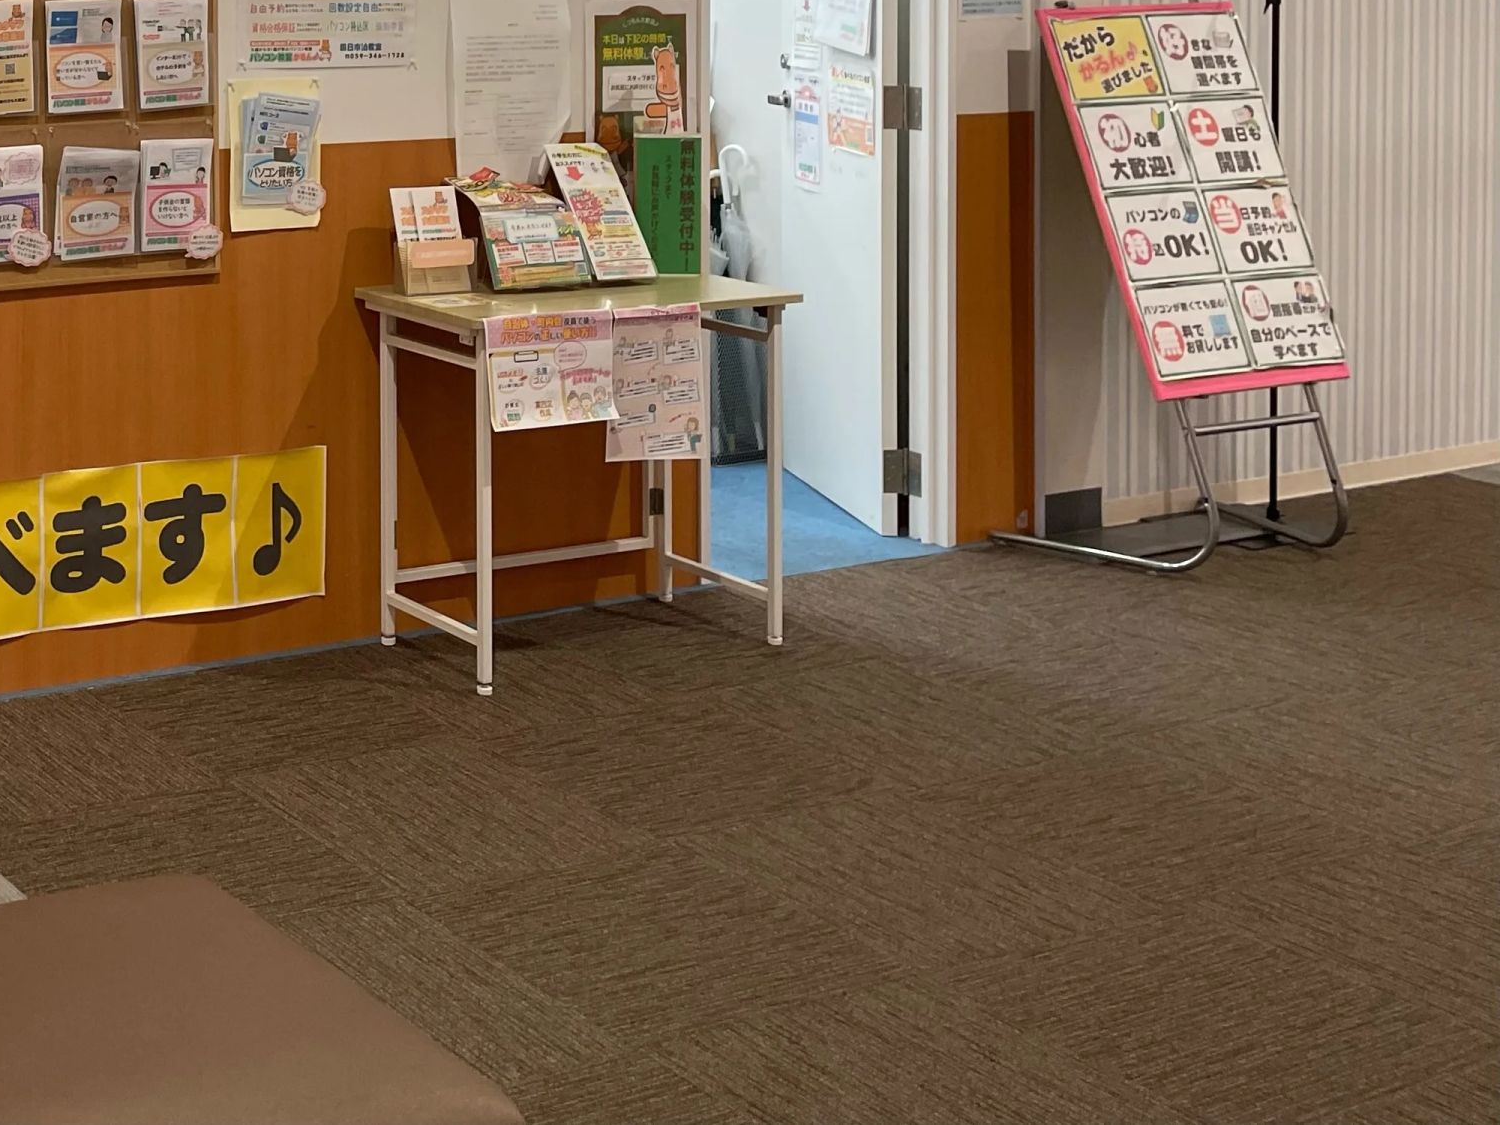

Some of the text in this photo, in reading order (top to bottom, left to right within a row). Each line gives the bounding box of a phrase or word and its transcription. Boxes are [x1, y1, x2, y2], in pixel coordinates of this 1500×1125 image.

[1063, 27, 1115, 62] だから
[1078, 49, 1127, 82] かるん
[1191, 55, 1238, 69] 時間帯を
[1101, 62, 1153, 93] 選びました
[1196, 72, 1242, 86] 選べます
[1188, 109, 1261, 147] 土曜日も
[1110, 156, 1176, 180] 大歓迎!
[1216, 150, 1261, 173] 開講!
[251, 167, 301, 178] パソコン資格を
[260, 178, 292, 187] とりたい方
[70, 212, 119, 223] 自営業の方へ
[1126, 208, 1181, 223] パソコンの
[1240, 239, 1288, 264] OK!
[1251, 322, 1332, 343] 自分のペースで
[1273, 342, 1317, 359] 学べます
